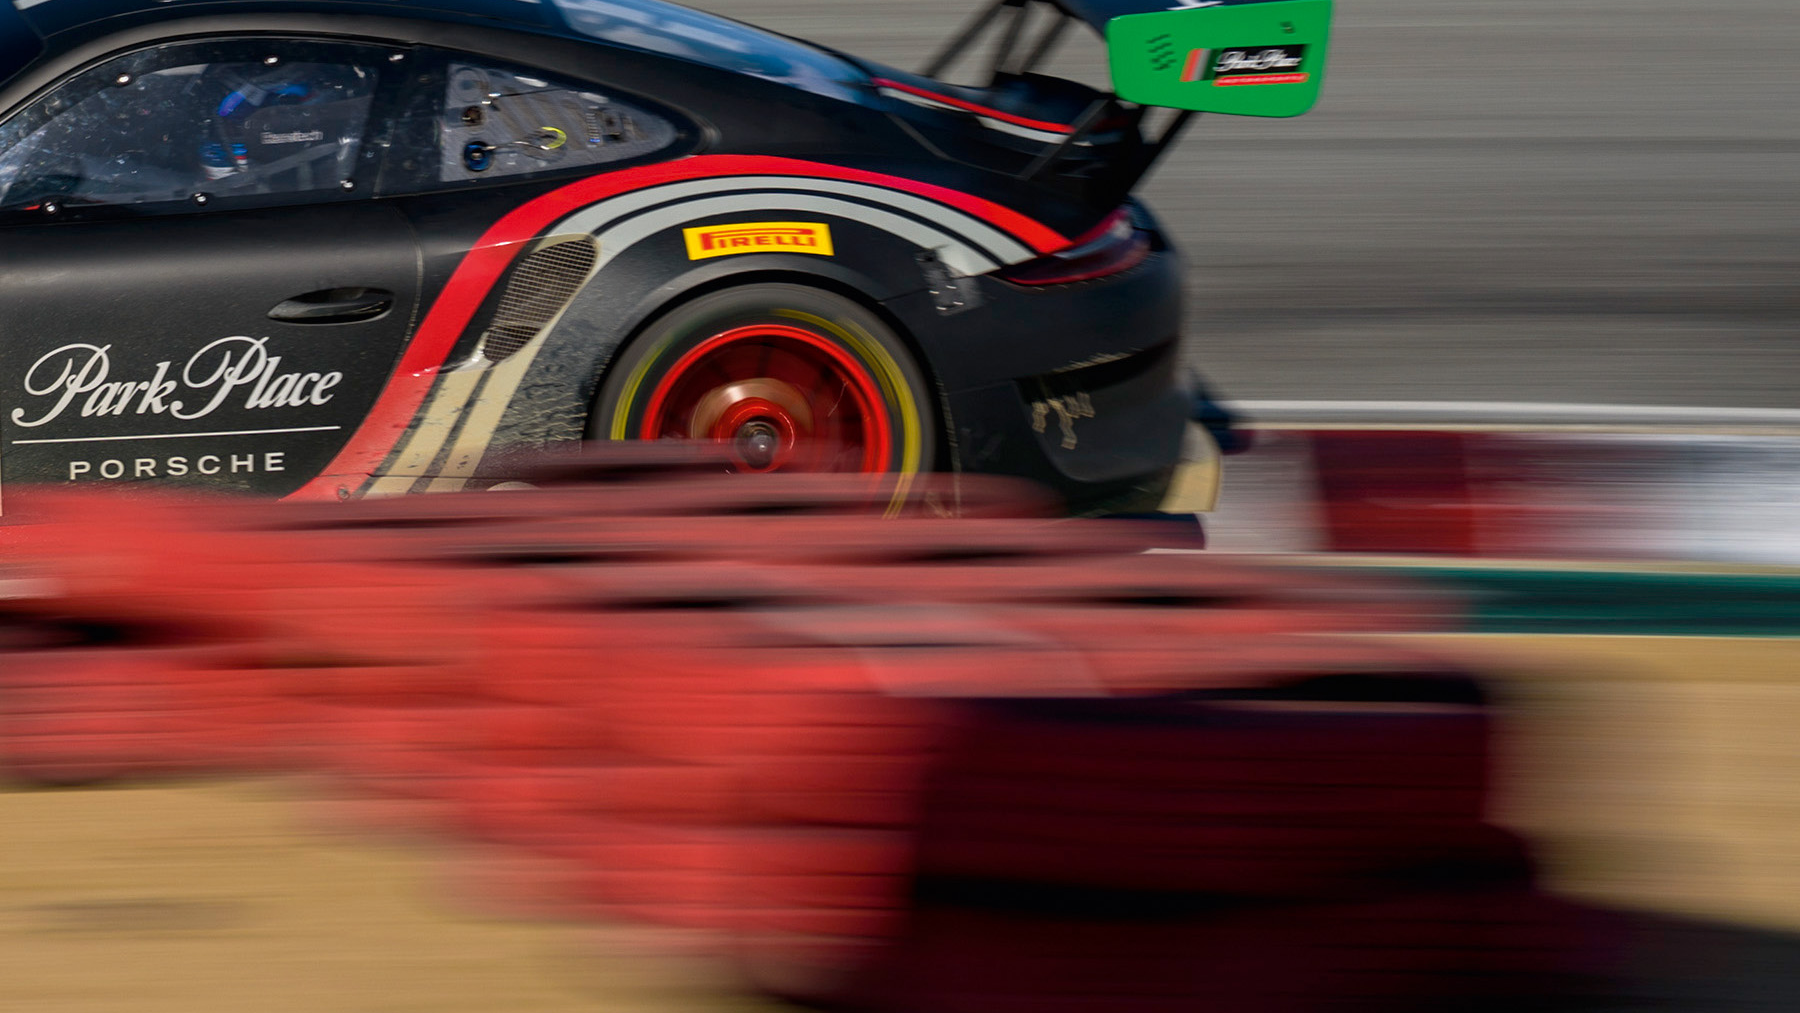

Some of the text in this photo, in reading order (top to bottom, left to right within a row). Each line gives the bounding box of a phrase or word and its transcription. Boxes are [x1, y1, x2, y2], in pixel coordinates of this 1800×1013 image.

[699, 227, 817, 251] PIRELLI
[11, 336, 343, 427] Park Place
[69, 452, 285, 480] PORSCHE
